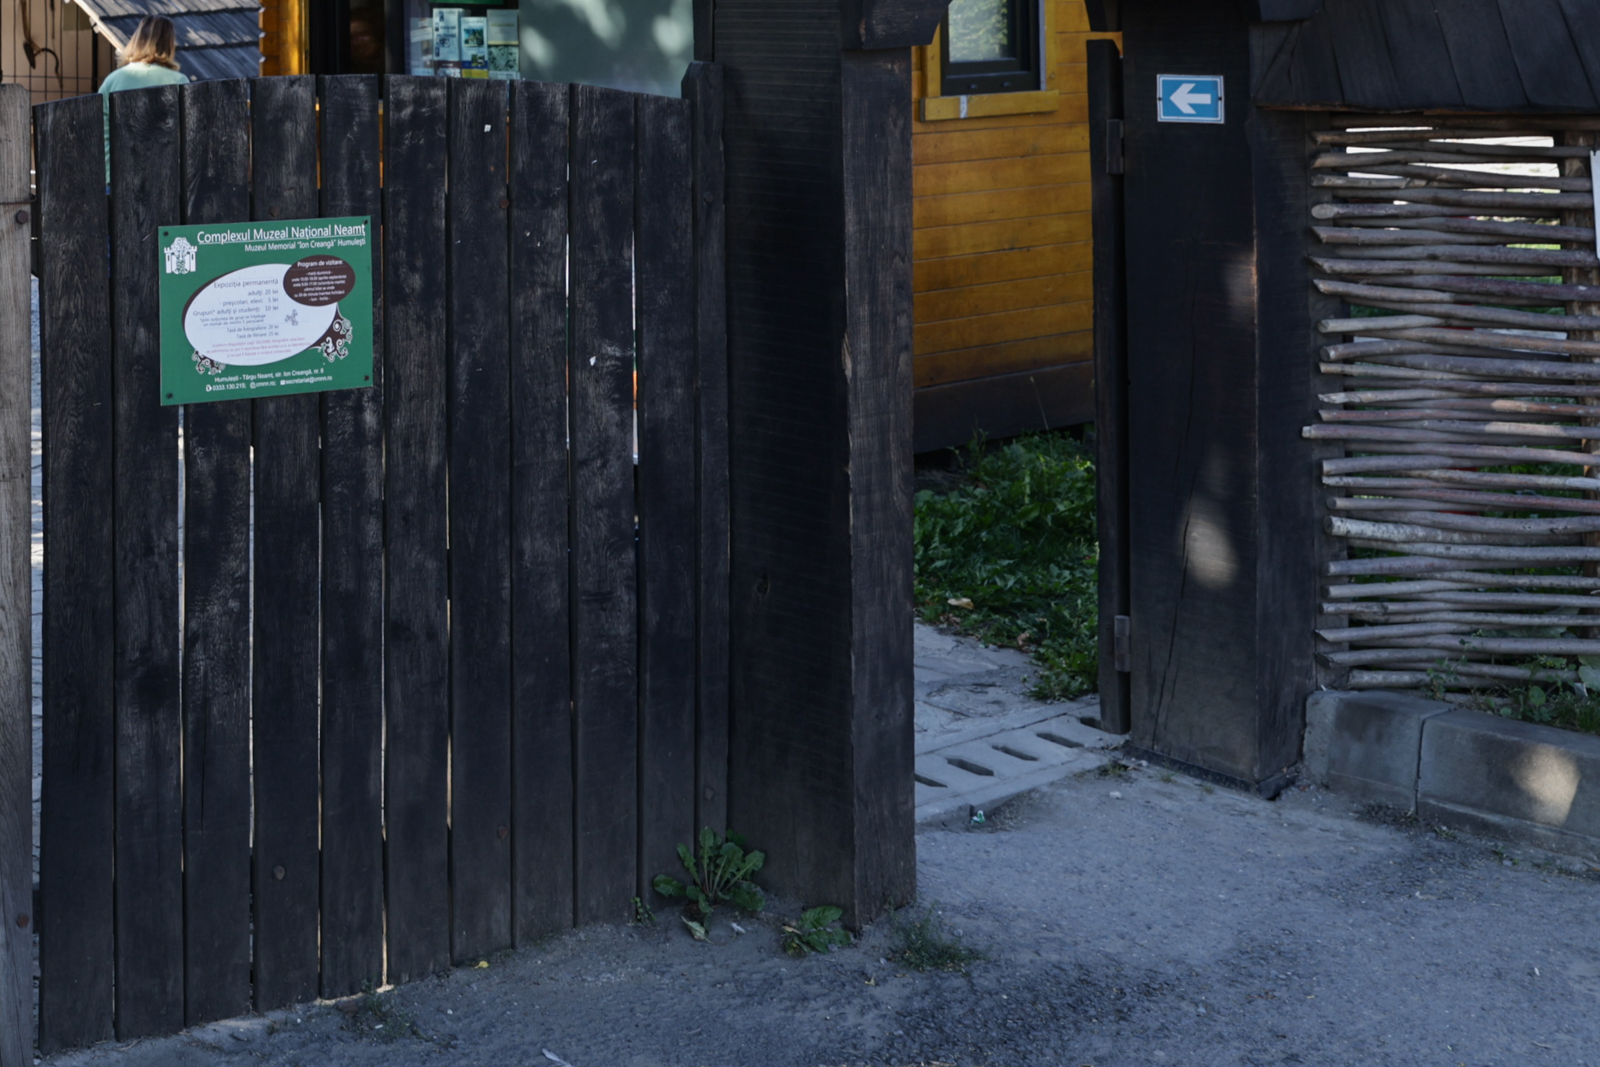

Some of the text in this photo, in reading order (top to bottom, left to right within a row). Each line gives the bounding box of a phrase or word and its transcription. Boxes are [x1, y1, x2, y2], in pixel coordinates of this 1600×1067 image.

[197, 229, 250, 245] Complexul
[254, 226, 288, 240] Muzeal
[244, 243, 267, 252] Muzeul
[268, 241, 296, 250] Memorial
[242, 279, 279, 288] permanentă
